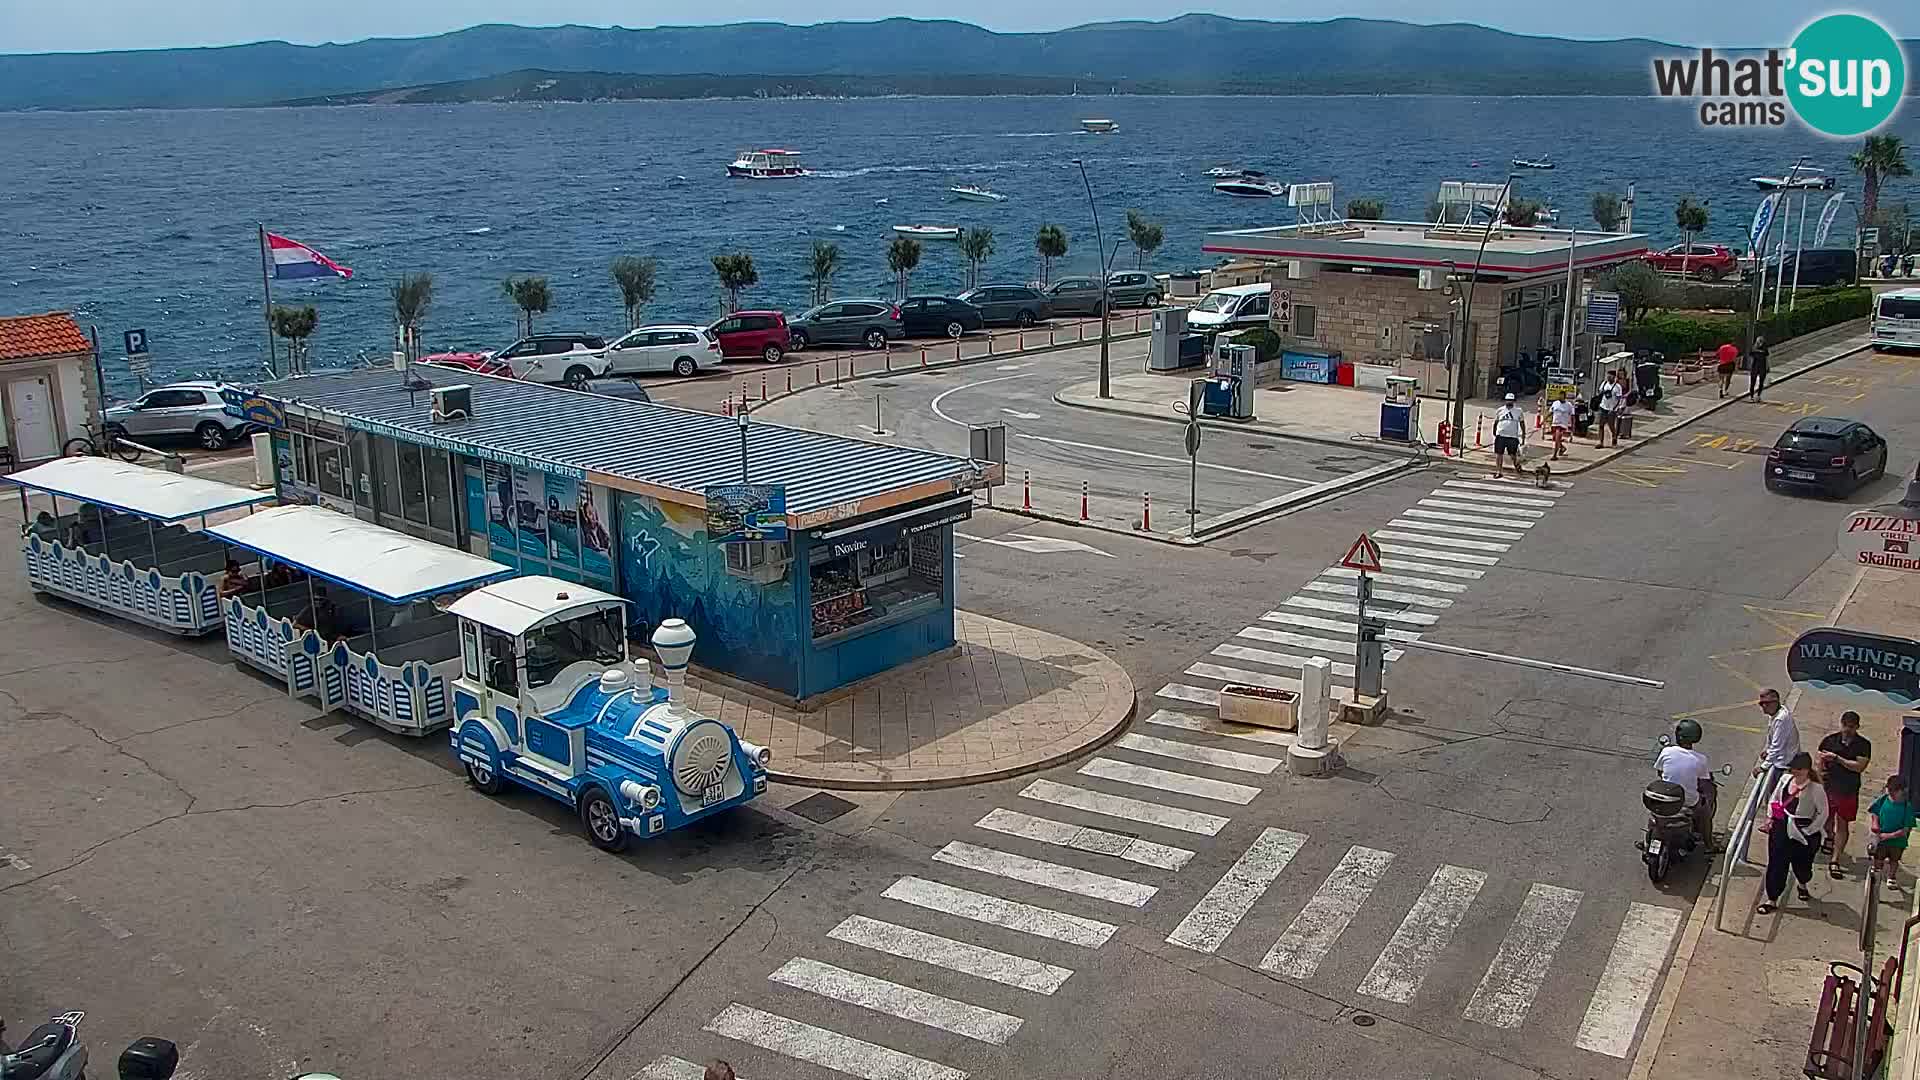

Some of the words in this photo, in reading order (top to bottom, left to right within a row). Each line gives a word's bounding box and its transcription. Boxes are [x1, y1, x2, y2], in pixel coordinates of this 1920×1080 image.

[129, 333, 141, 351] P
[395, 429, 435, 446] AUTOBUSNA
[436, 439, 467, 453] POSTAJA
[477, 448, 492, 459] BUS
[493, 453, 525, 466] STATION
[528, 459, 553, 473] TICKET
[554, 465, 582, 479] OFFICE
[1880, 532, 1916, 542] GRILL
[1799, 643, 1920, 674] MARINER
[1869, 667, 1896, 681] bar
